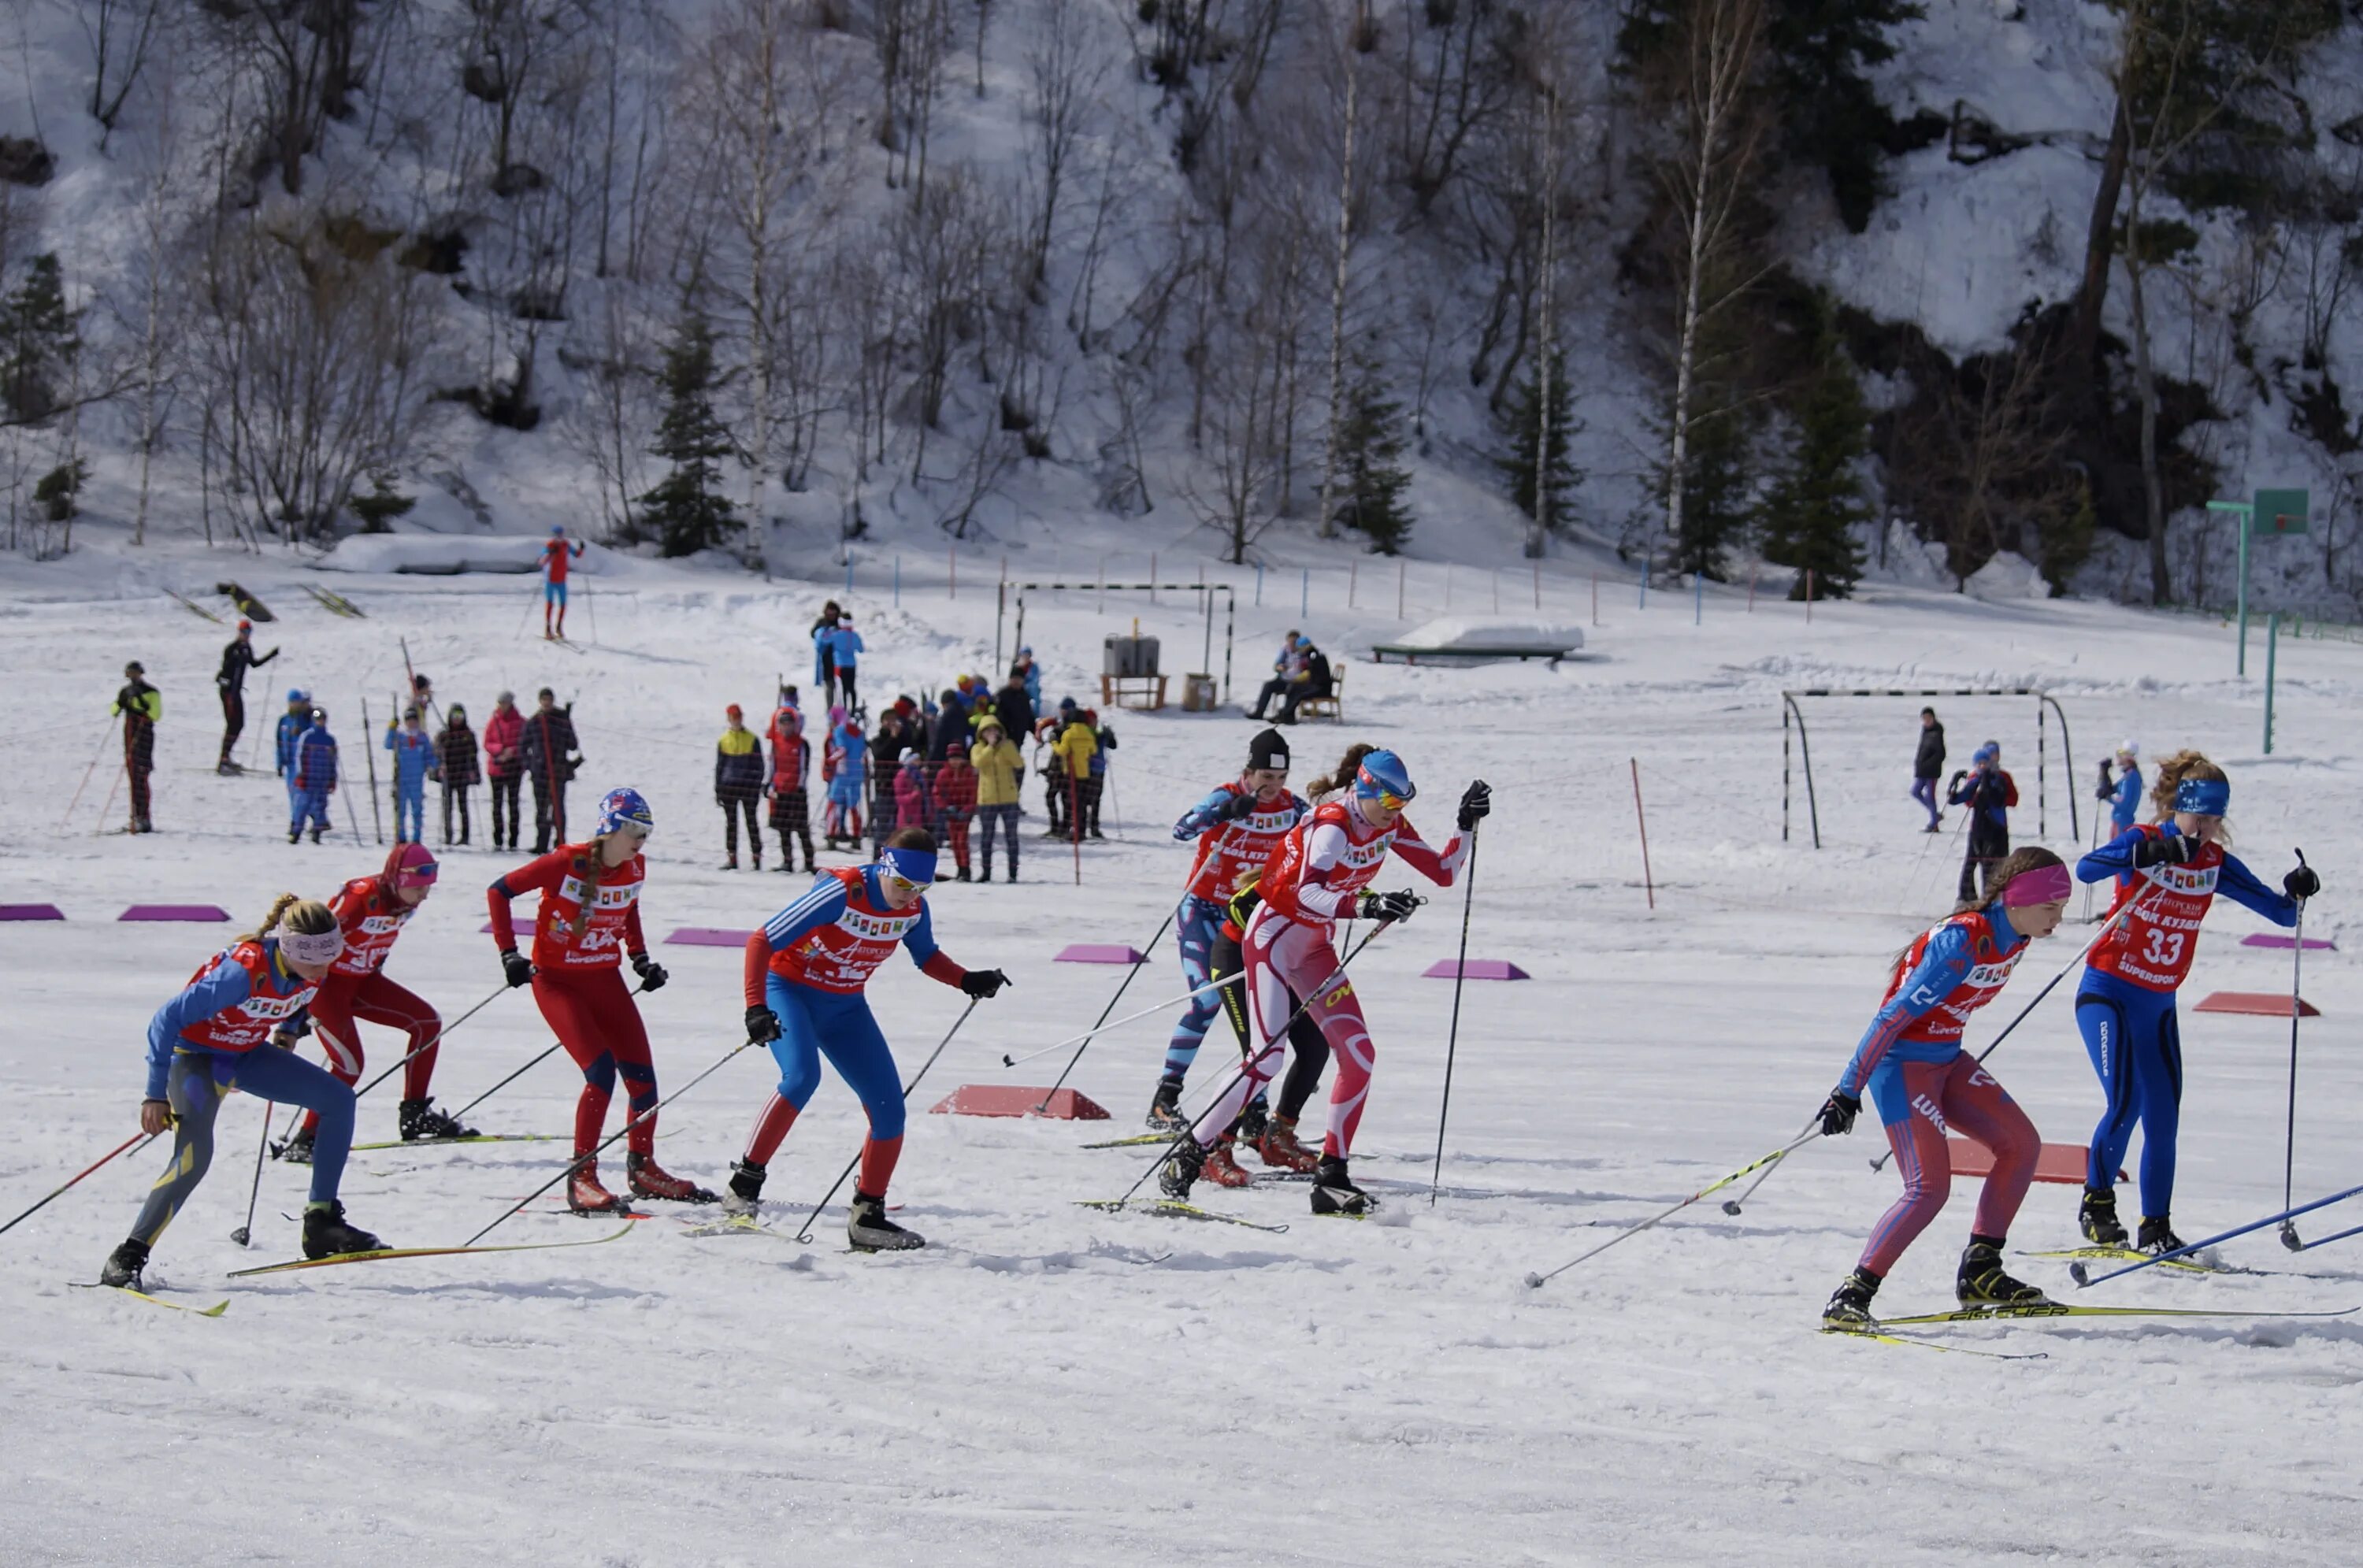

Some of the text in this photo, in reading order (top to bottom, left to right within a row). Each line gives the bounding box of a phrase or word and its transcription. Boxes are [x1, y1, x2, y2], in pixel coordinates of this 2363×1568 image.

[2142, 928, 2185, 966] 33
[2078, 1250, 2125, 1259] FISCHER
[1949, 1307, 2070, 1321] FISCHER
